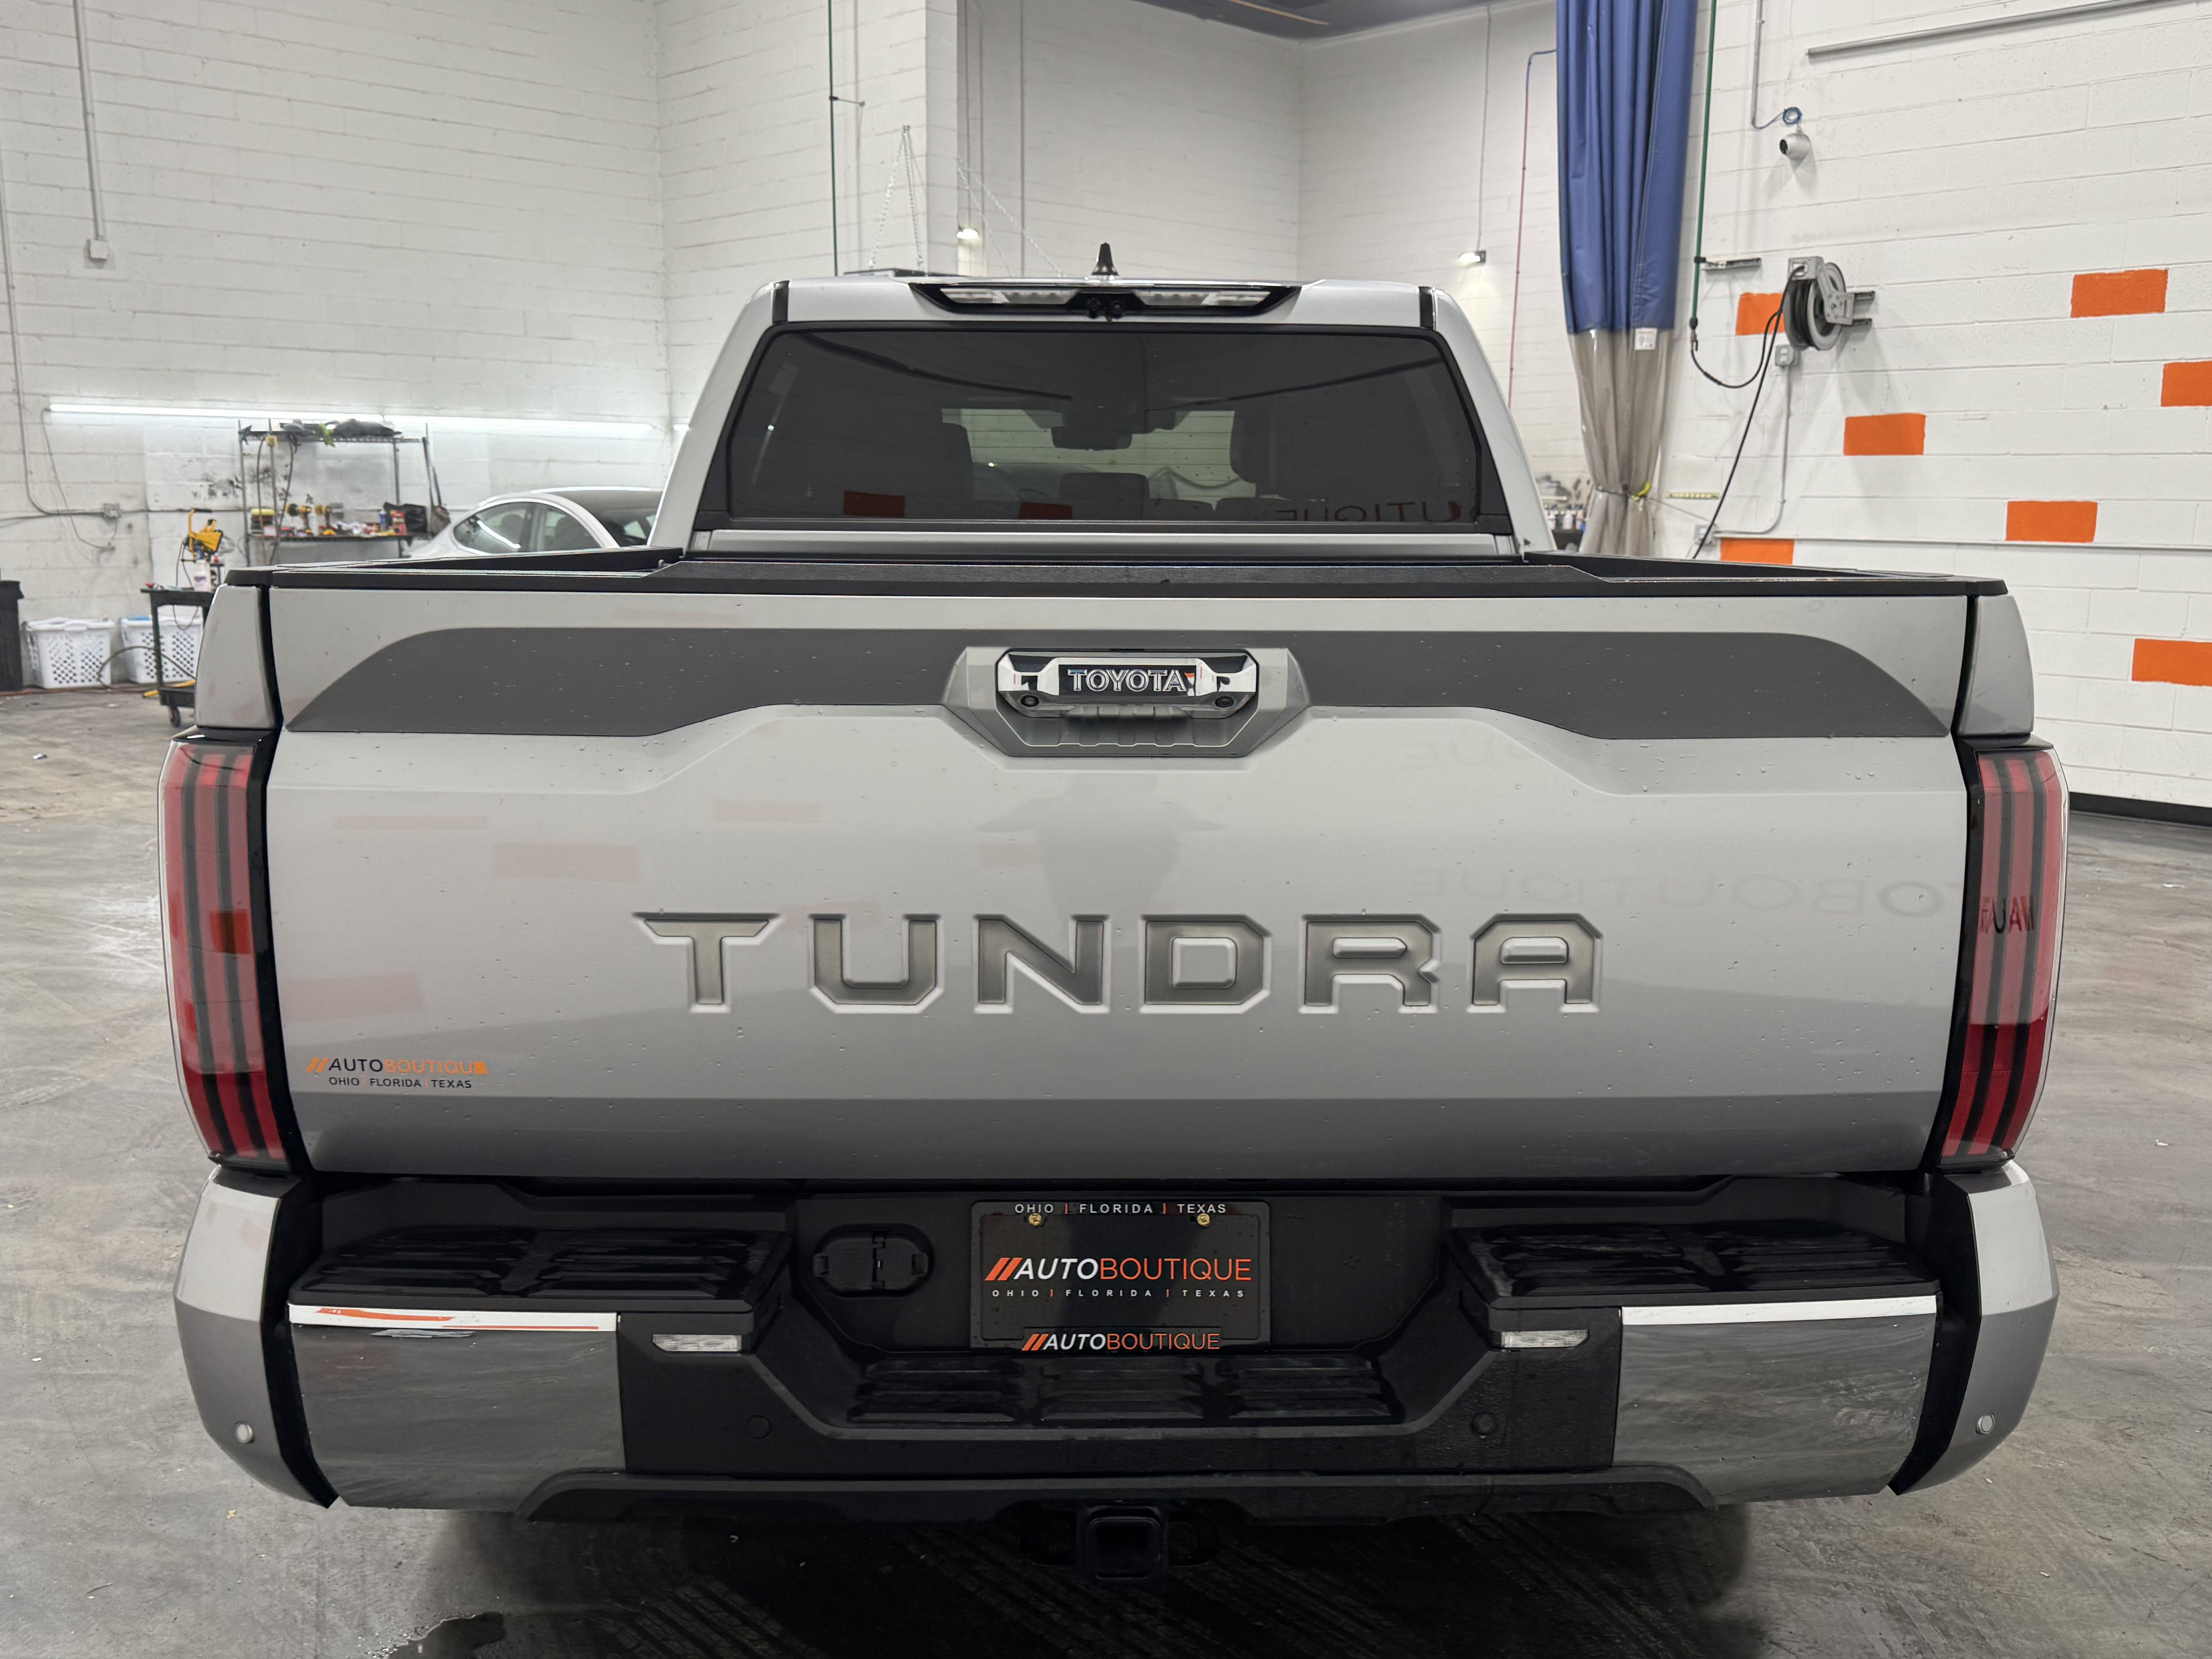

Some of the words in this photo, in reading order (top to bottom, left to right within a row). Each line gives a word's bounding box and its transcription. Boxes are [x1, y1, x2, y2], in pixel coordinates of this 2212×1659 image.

[1067, 669, 1187, 692] TOYOTA
[632, 912, 1603, 1013] TUNDRA
[329, 1077, 359, 1085] OHIO
[370, 1078, 421, 1087] FLORIDA
[431, 1080, 471, 1088] TEXAS
[1015, 1204, 1053, 1213] OHIO
[1080, 1204, 1153, 1213] FLORIDA
[1177, 1204, 1226, 1213] TEXAS
[1013, 1258, 1252, 1280] AUTOBOUTIQUE
[1043, 1333, 1220, 1350] AUTOBOUTIQUE
